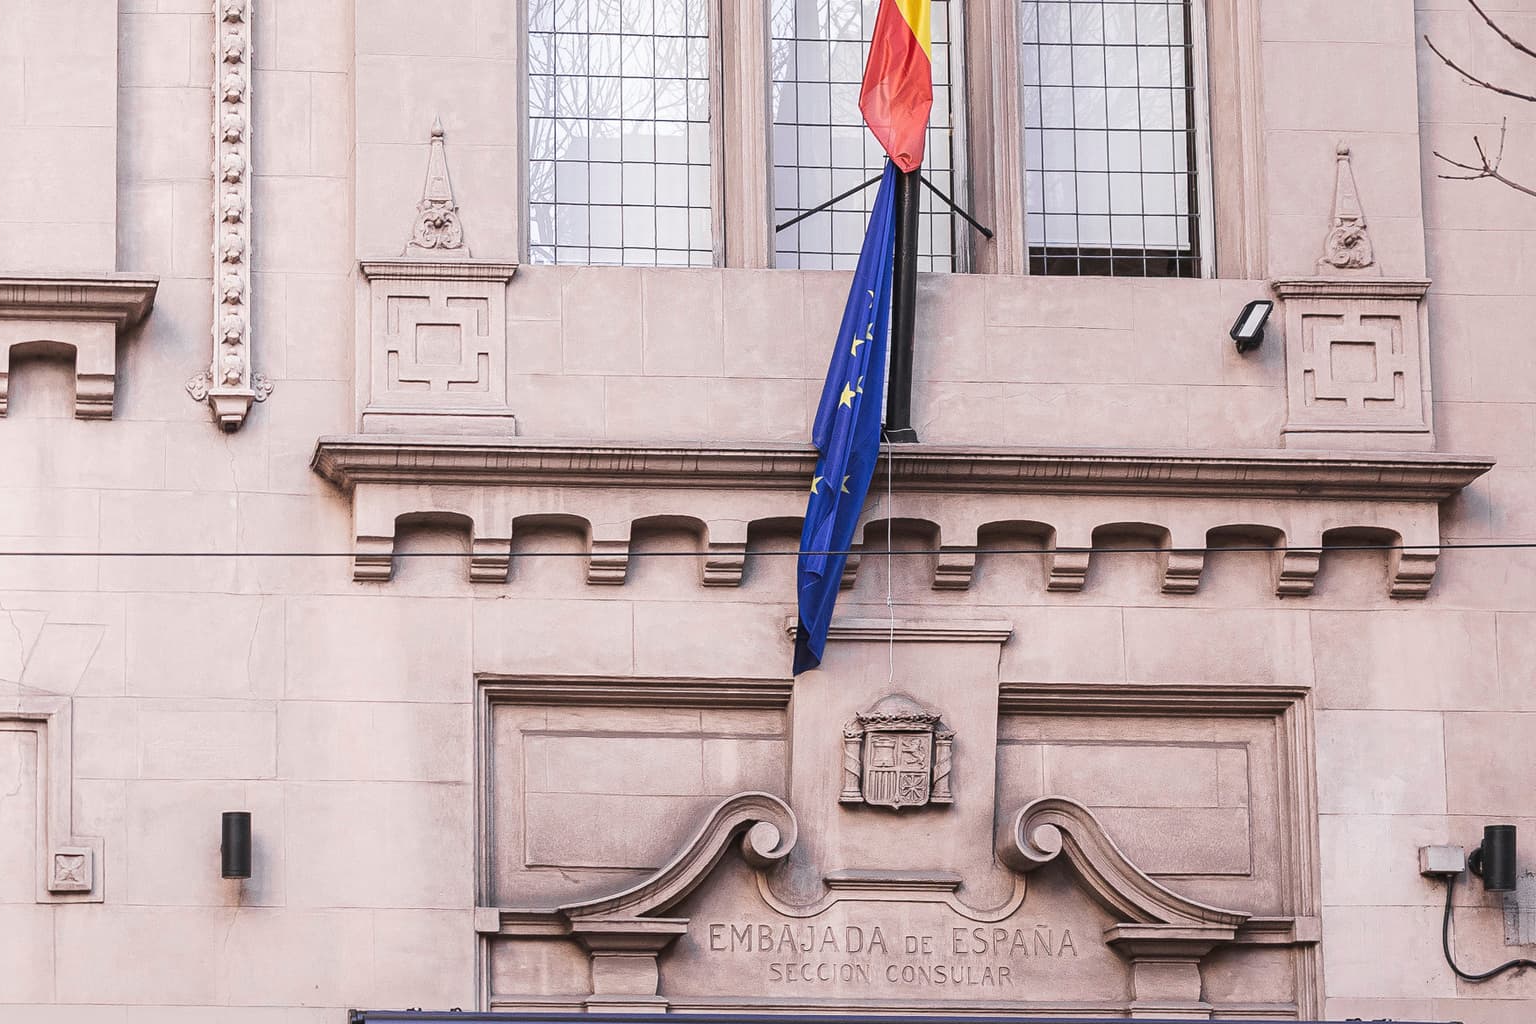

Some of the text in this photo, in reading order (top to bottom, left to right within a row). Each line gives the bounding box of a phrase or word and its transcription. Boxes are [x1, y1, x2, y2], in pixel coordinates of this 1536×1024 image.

[709, 923, 1078, 957] EMBAJADA DE ESPAÑA
[768, 962, 1014, 986] SECCION CONSULAR
